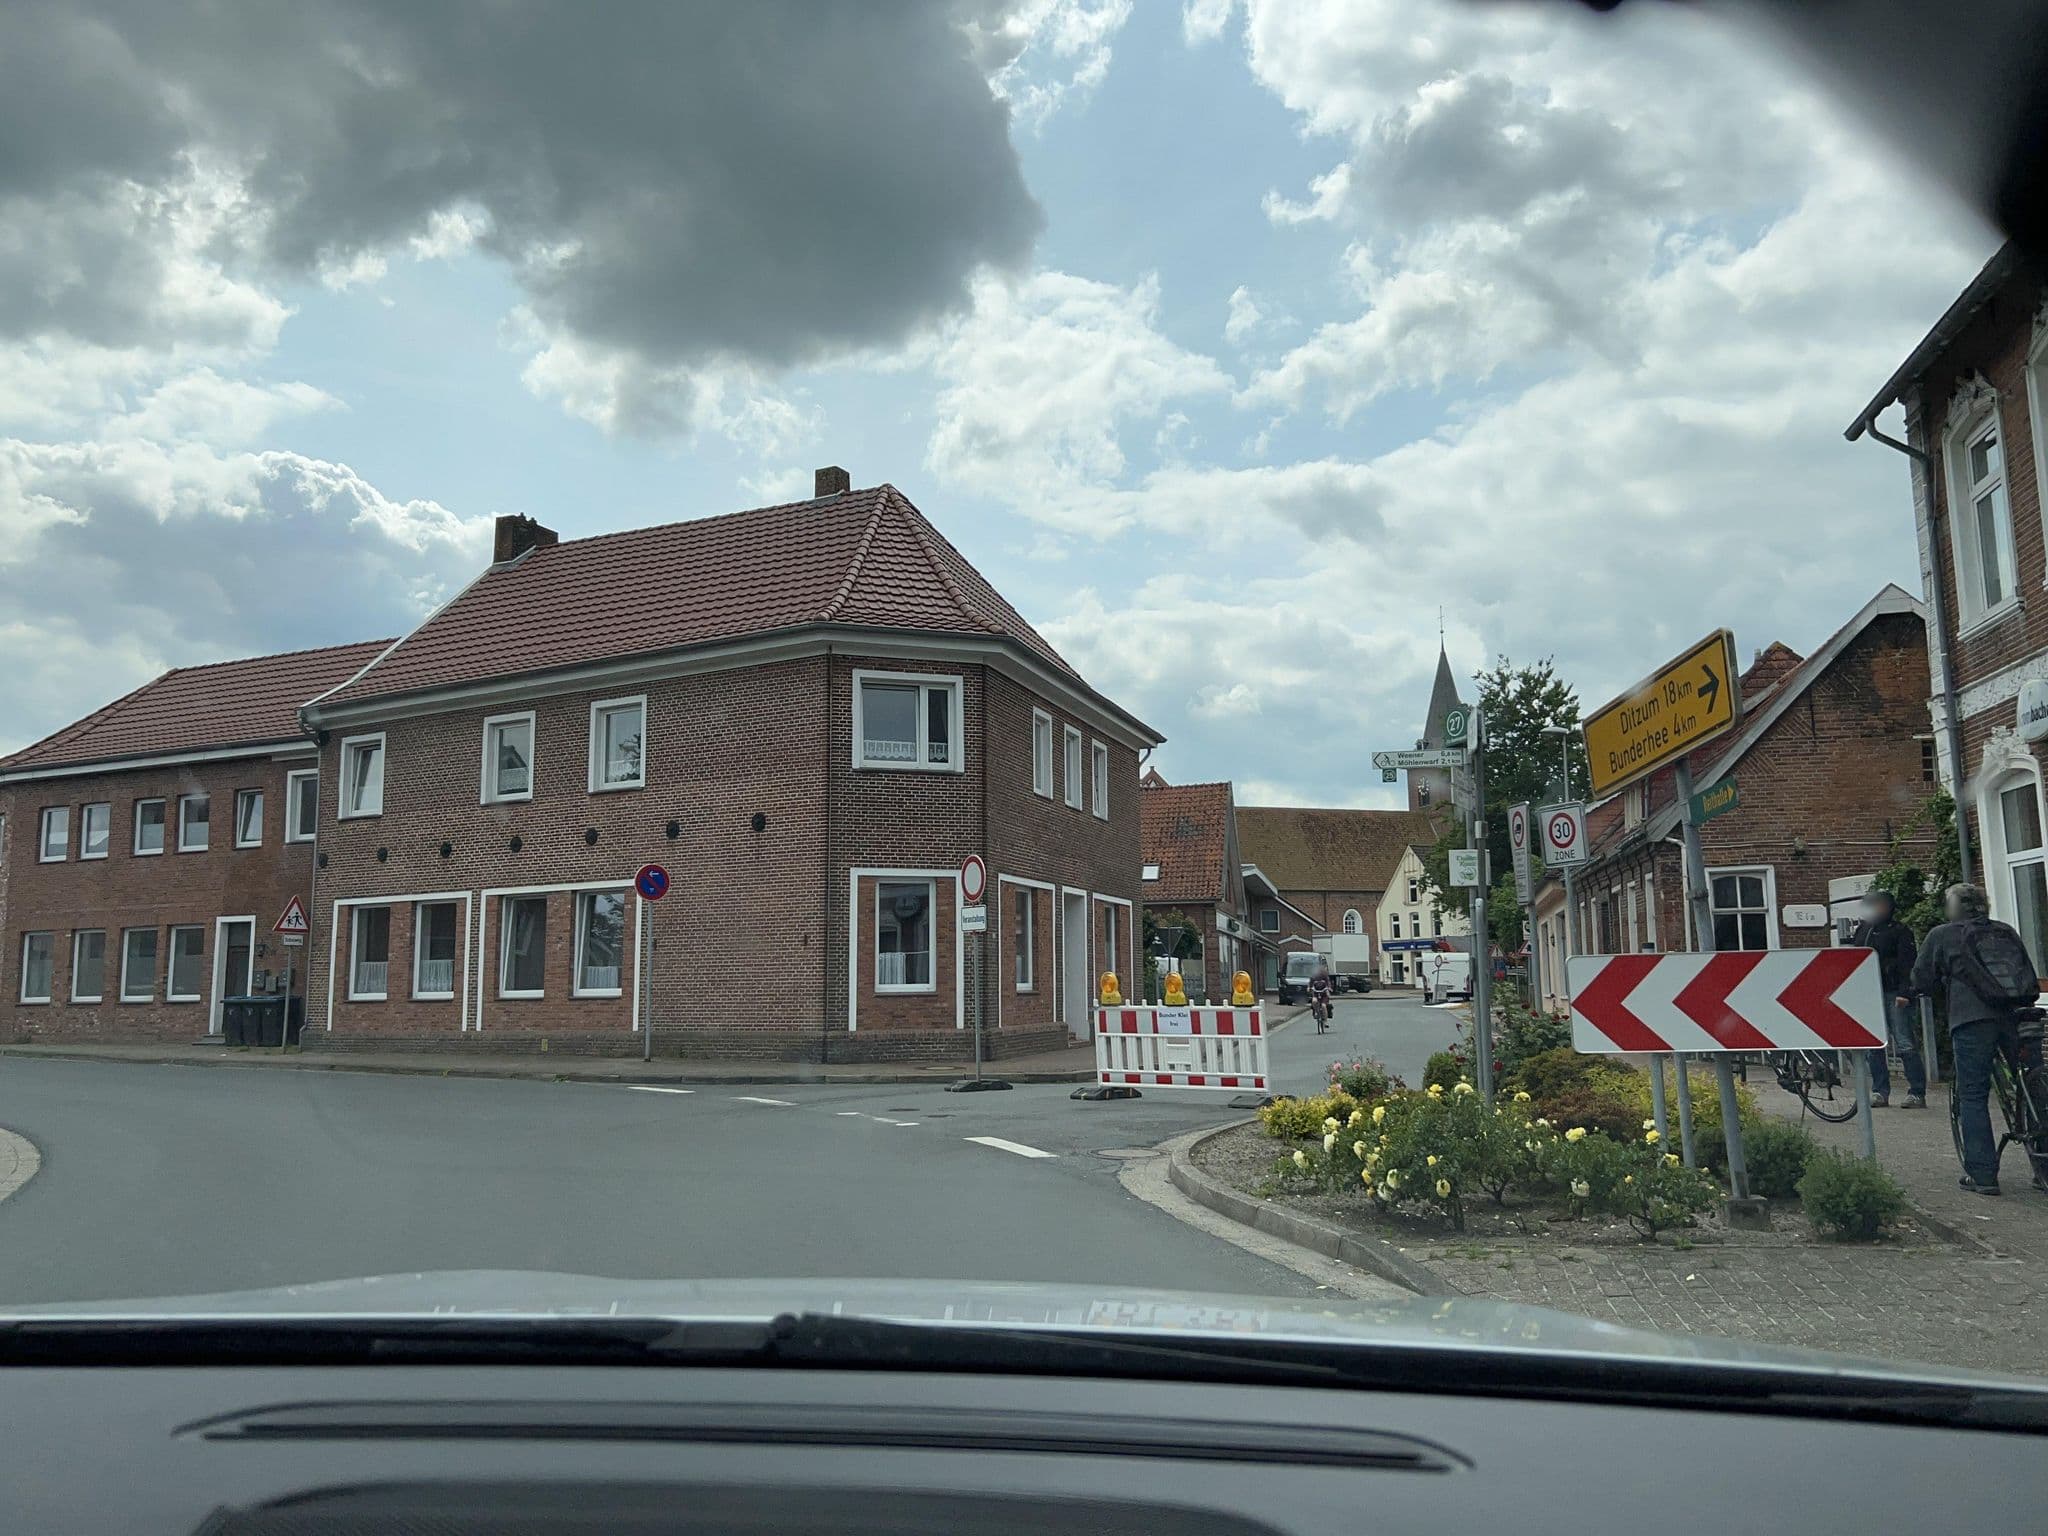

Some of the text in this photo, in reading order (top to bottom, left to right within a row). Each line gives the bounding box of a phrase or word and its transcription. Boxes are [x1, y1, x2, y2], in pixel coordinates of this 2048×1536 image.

[1449, 716, 1461, 732] 27
[1620, 697, 1660, 735] Ditzum
[1608, 726, 1669, 774] Bunderhee
[1554, 821, 1571, 840] 30
[1554, 849, 1576, 860] ZONE
